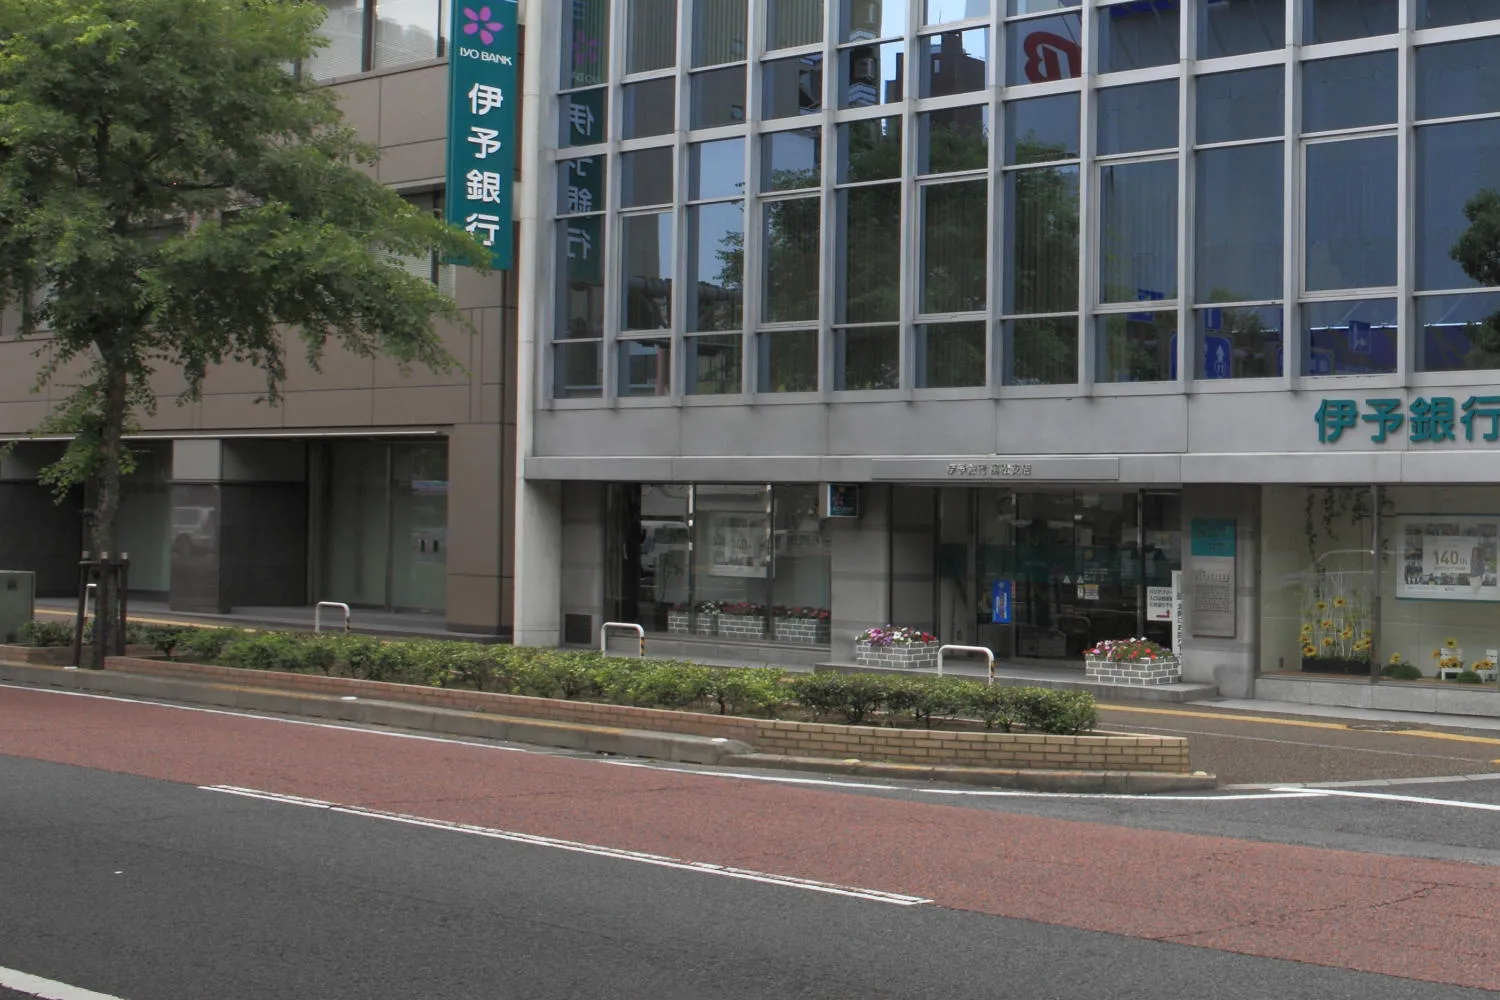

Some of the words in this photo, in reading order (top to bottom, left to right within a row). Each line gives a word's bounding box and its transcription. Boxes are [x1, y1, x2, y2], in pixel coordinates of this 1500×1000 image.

[460, 47, 479, 59] IYO
[481, 51, 512, 66] BANK
[466, 82, 503, 248] 伊予銀行
